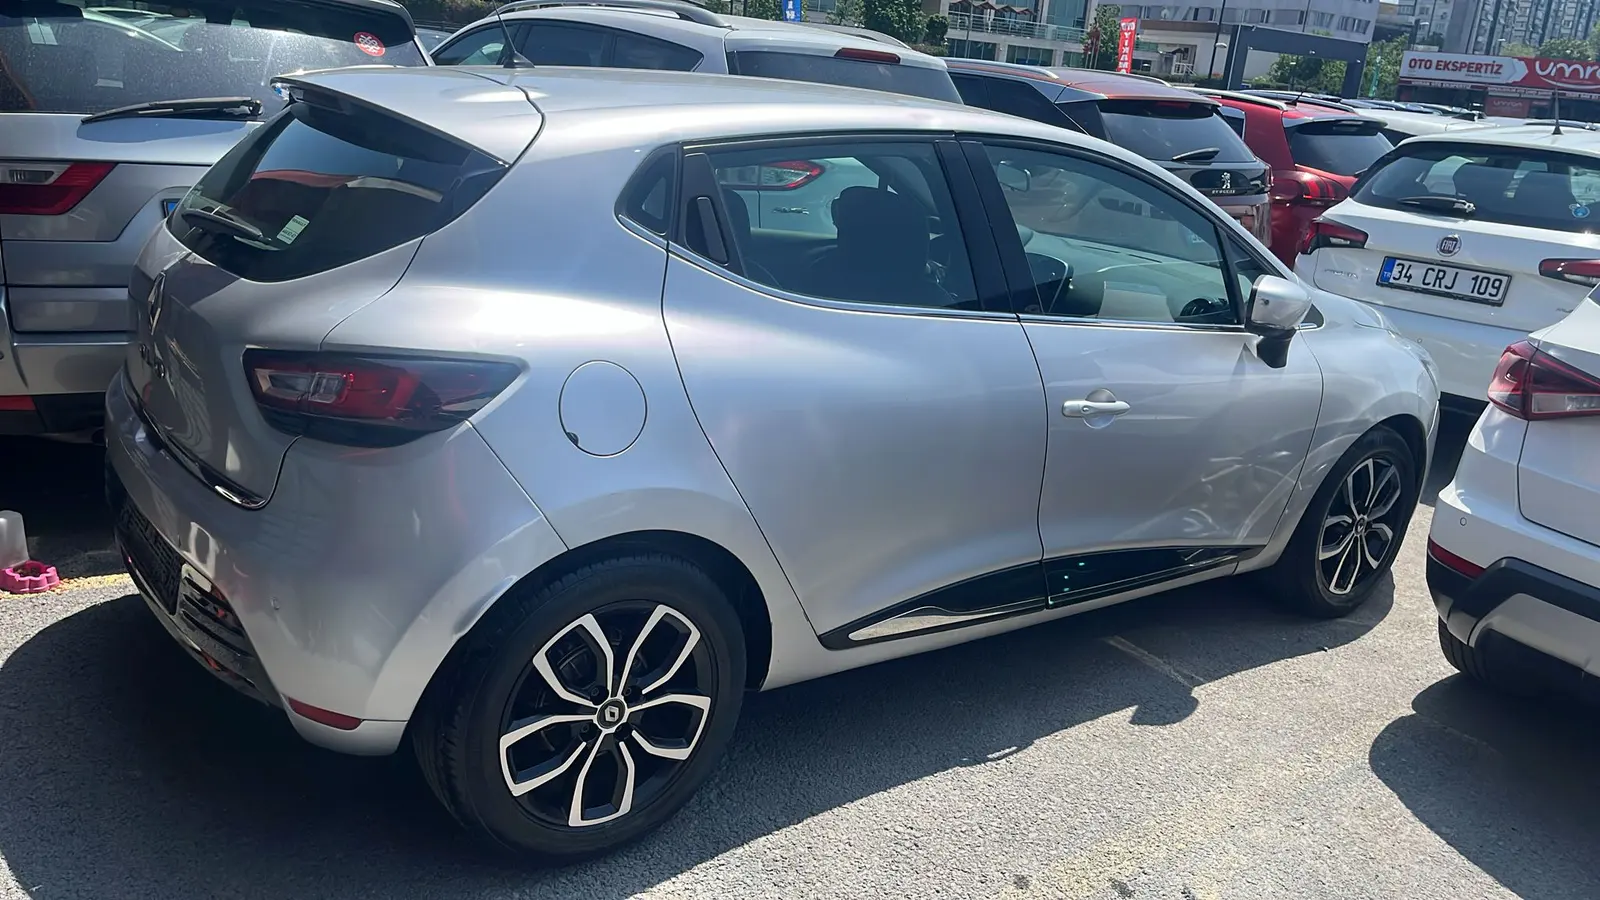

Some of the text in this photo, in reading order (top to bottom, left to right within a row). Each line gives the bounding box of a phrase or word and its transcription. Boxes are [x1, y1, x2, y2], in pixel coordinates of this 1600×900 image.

[1409, 58, 1504, 75] OTO EKSPERTİZ
[1441, 239, 1457, 251] FIAT
[1392, 262, 1413, 283] 34
[1421, 267, 1459, 290] CRJ
[1470, 274, 1503, 298] 109
